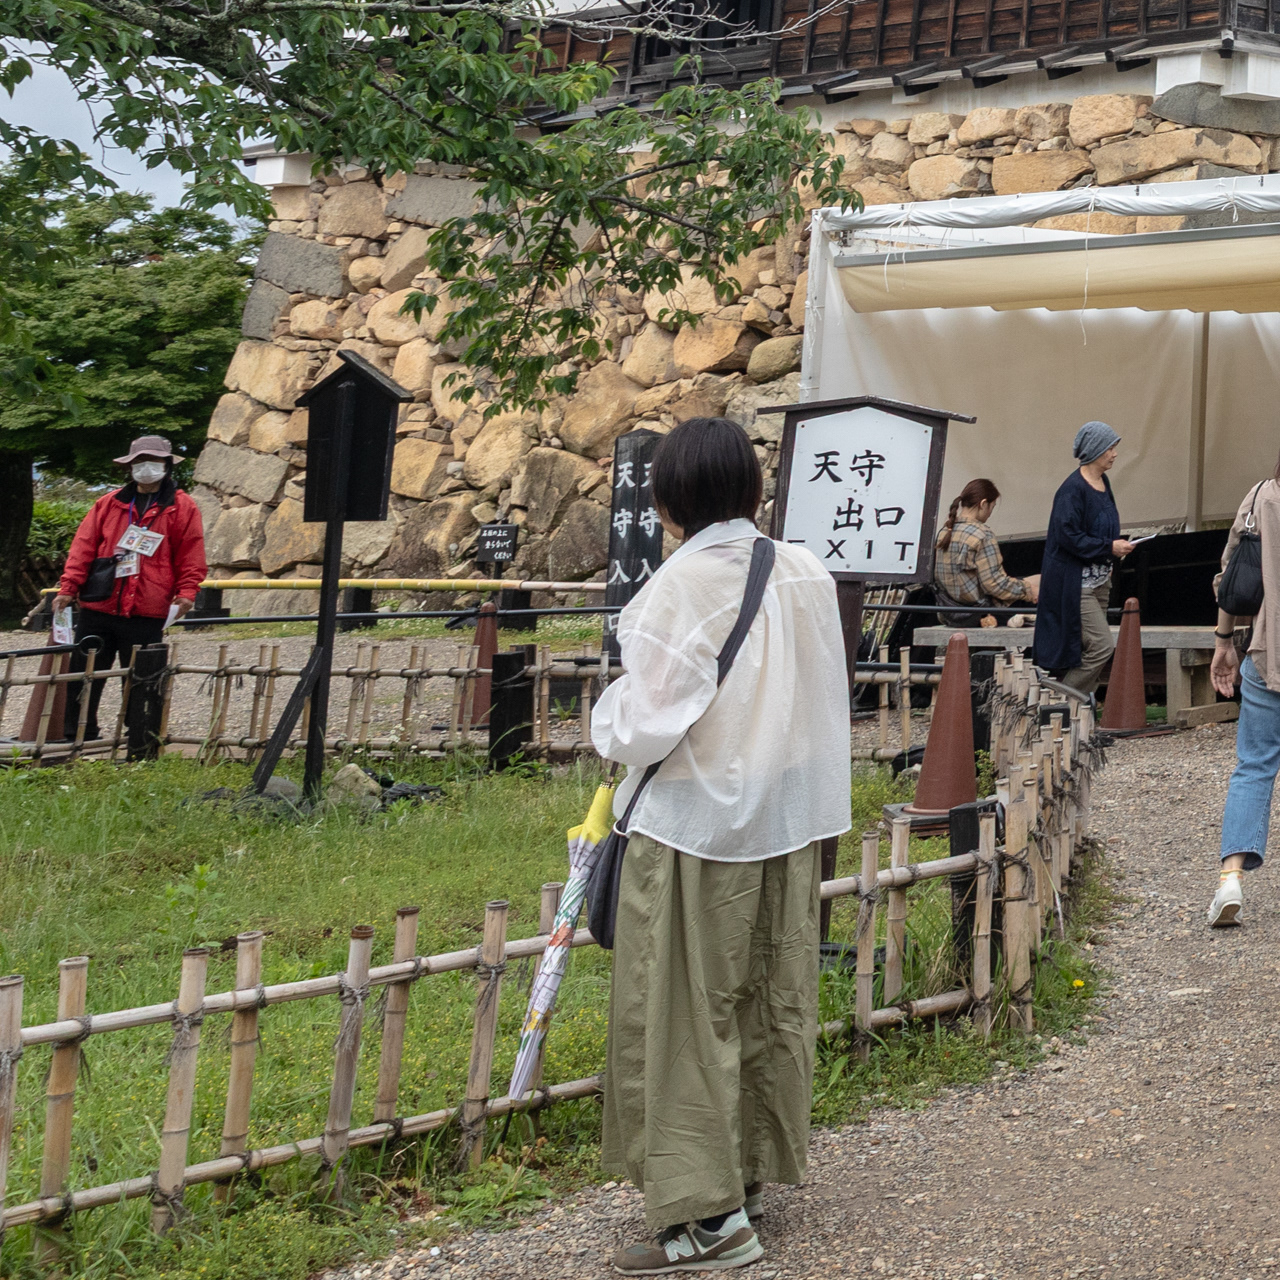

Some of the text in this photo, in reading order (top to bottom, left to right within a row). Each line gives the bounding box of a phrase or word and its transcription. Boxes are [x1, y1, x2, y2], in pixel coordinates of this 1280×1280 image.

[807, 449, 886, 487] 天守
[833, 497, 906, 532] 出口
[787, 539, 915, 561] XIT
